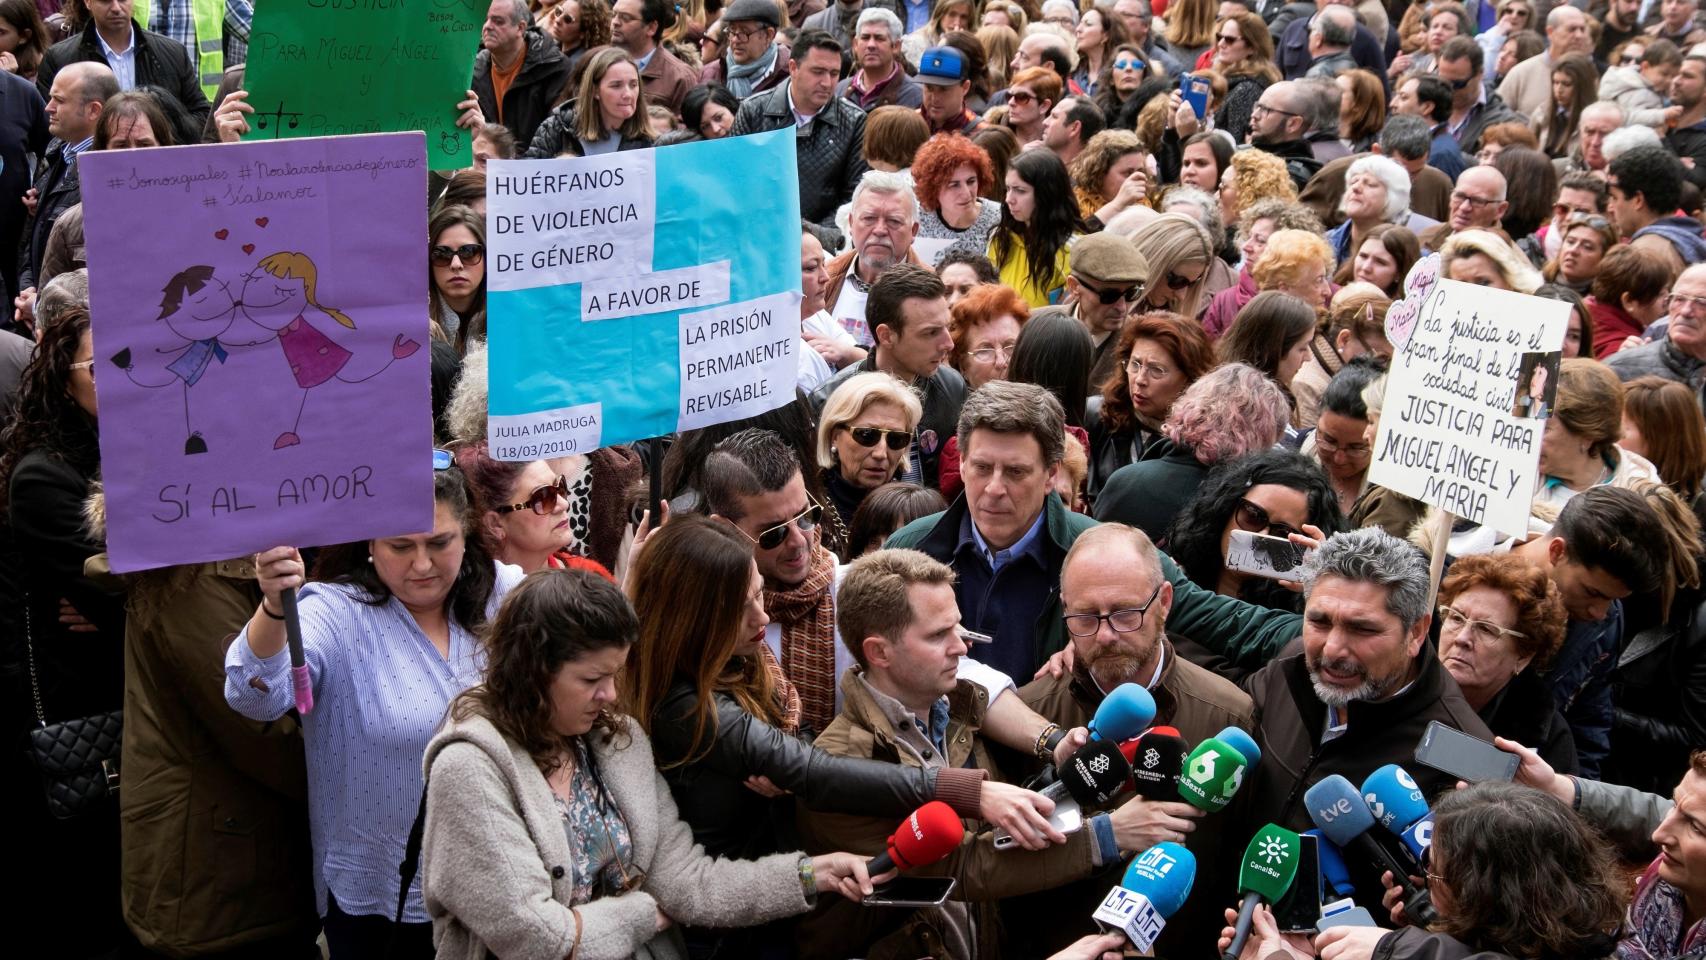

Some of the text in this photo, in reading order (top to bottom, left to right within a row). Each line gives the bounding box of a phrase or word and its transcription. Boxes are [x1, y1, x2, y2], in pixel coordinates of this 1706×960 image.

[254, 32, 307, 65] PARA
[317, 36, 373, 69] MIGUEL
[495, 167, 625, 196] HUÉRFANOS
[496, 203, 638, 234] DE VIOLENCIA
[496, 242, 614, 272] DE GÉNERO
[587, 280, 701, 314] A FAVOR DE
[686, 308, 772, 346] LA PRISIÓN
[1449, 311, 1503, 344] justicia
[1506, 328, 1522, 344] es
[1527, 323, 1545, 350] el
[687, 338, 791, 381] PERMANENTE
[1402, 337, 1439, 368] gran
[1442, 343, 1481, 374] final
[1486, 353, 1502, 377] de
[686, 379, 773, 415] REVISABLE.
[1422, 371, 1514, 413] sociedad civil
[495, 415, 597, 439] JULIA MADRUGA
[1401, 395, 1533, 454] JUSTICIA PARA
[496, 437, 578, 460] (18/03/2010)
[1378, 429, 1521, 499] MIGUEL ANGEL Y
[212, 487, 256, 517] AL
[278, 465, 375, 507] AMOR
[1419, 475, 1488, 525] MARIA
[1320, 798, 1352, 822] tve
